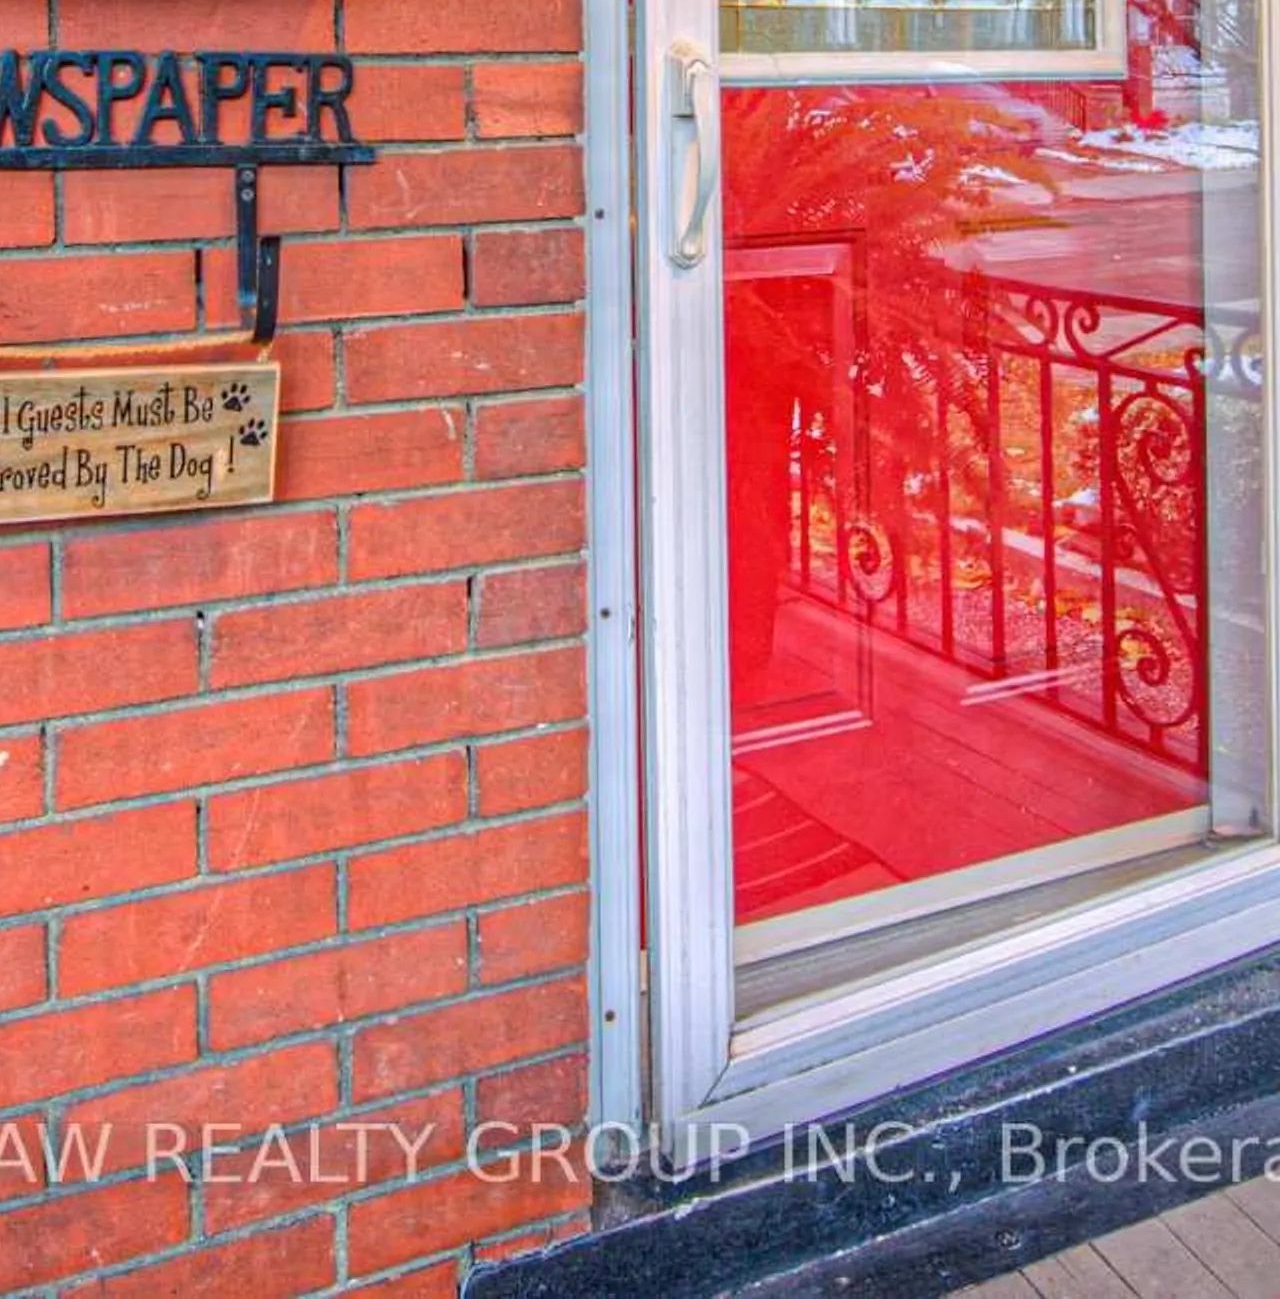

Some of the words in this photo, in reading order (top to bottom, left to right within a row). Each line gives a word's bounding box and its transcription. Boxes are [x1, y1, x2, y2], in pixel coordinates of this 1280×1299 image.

[18, 386, 104, 450] Guests
[111, 382, 175, 428] Must
[184, 387, 214, 423] Be
[76, 448, 108, 509] By
[116, 444, 161, 485] The
